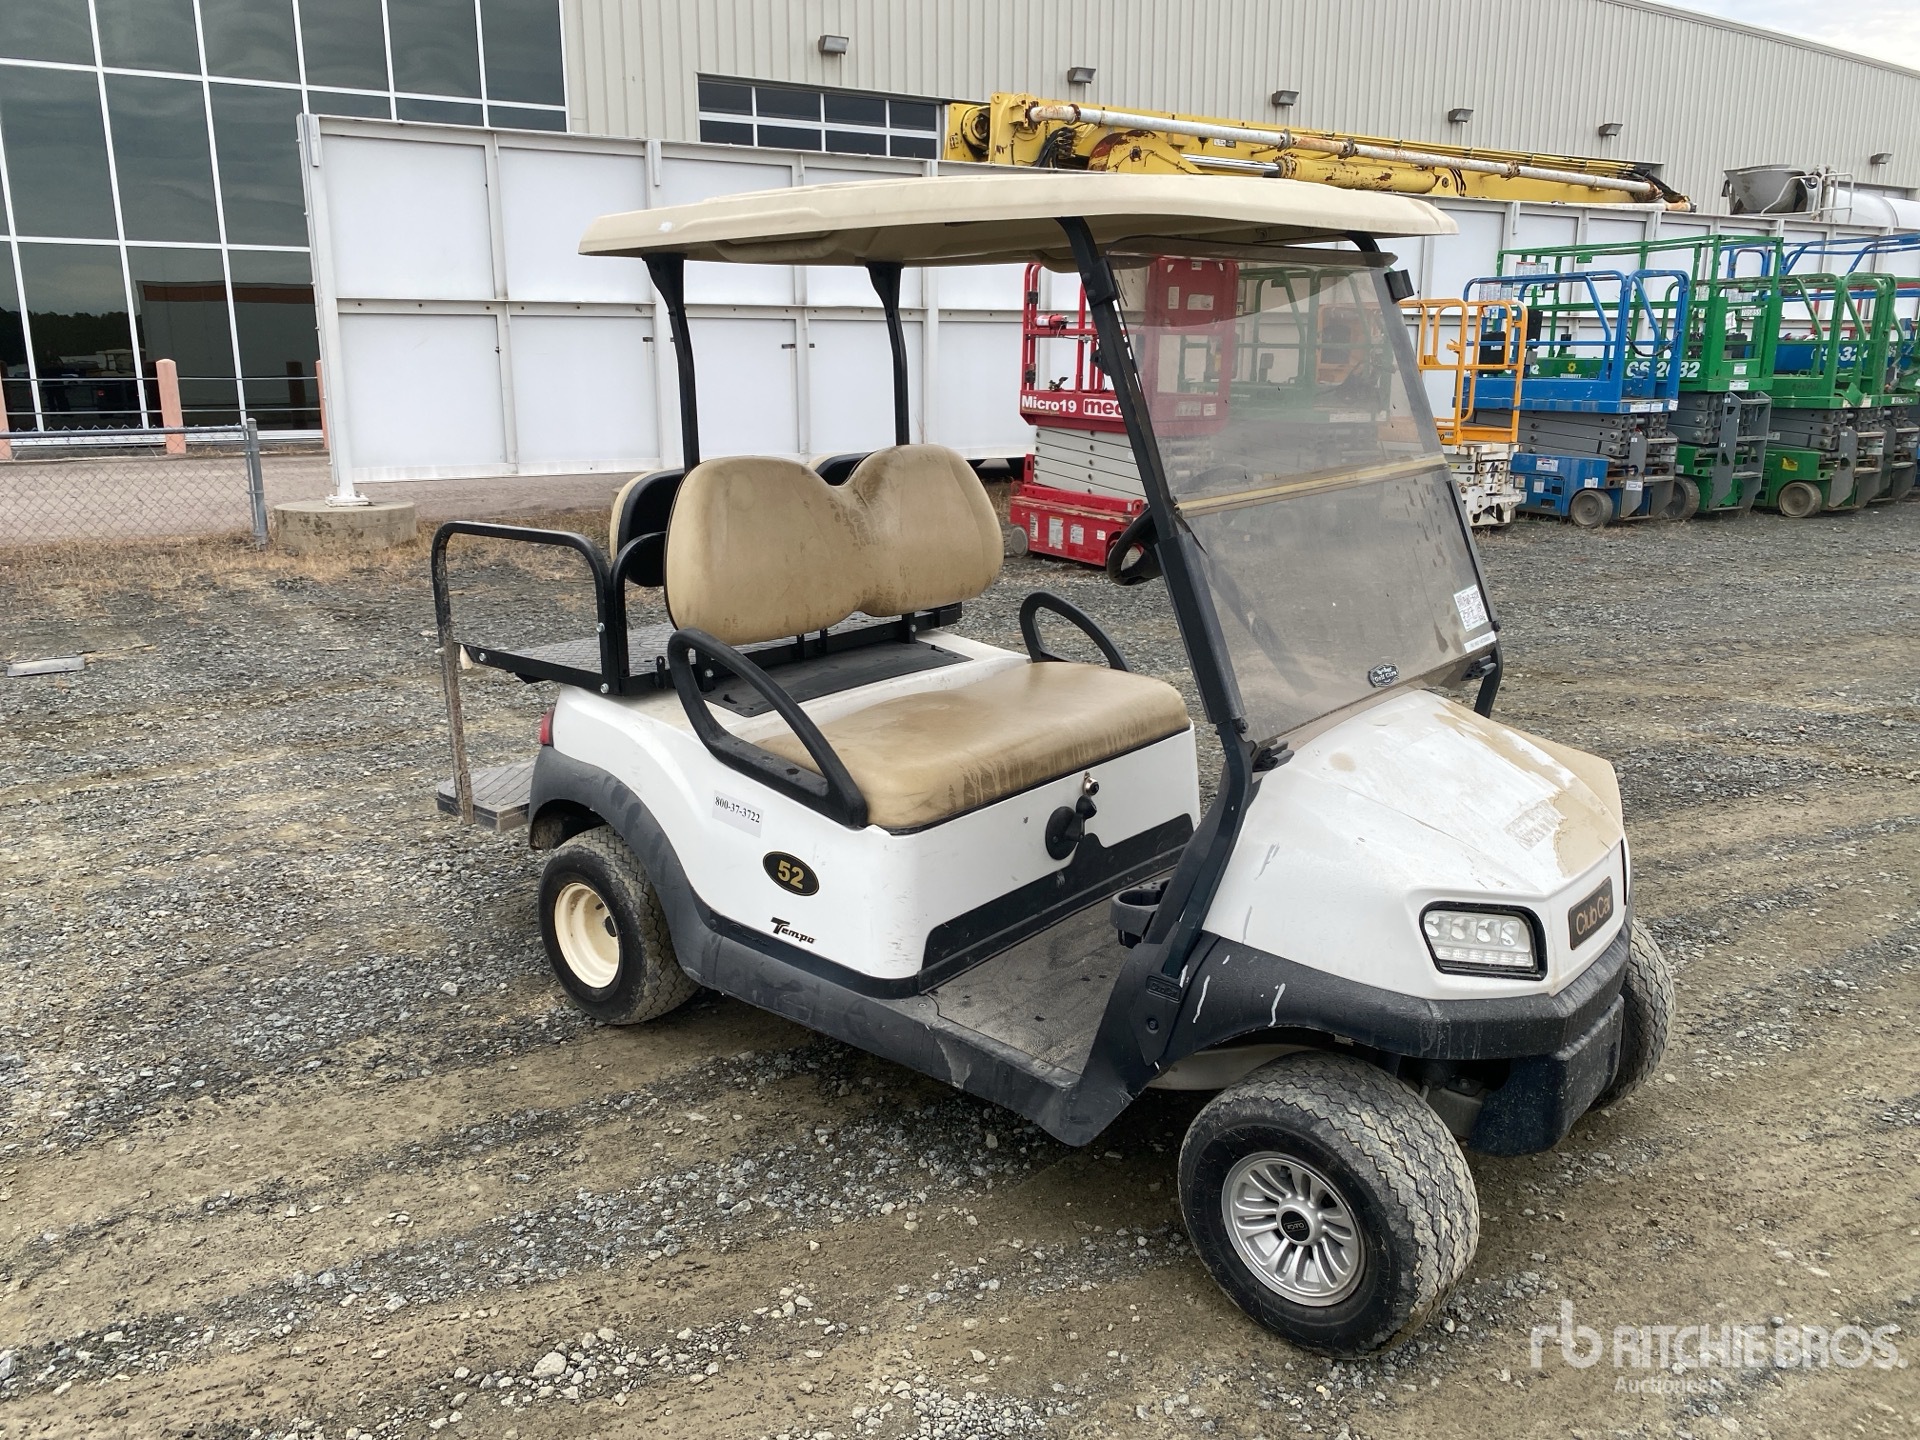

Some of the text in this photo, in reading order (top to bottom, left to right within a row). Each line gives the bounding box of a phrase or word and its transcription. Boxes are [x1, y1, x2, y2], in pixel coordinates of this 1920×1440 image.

[1021, 395, 1077, 413] Micro19
[714, 796, 761, 824] 800-37-3722
[777, 859, 805, 890] 52
[771, 916, 817, 945] Tempo
